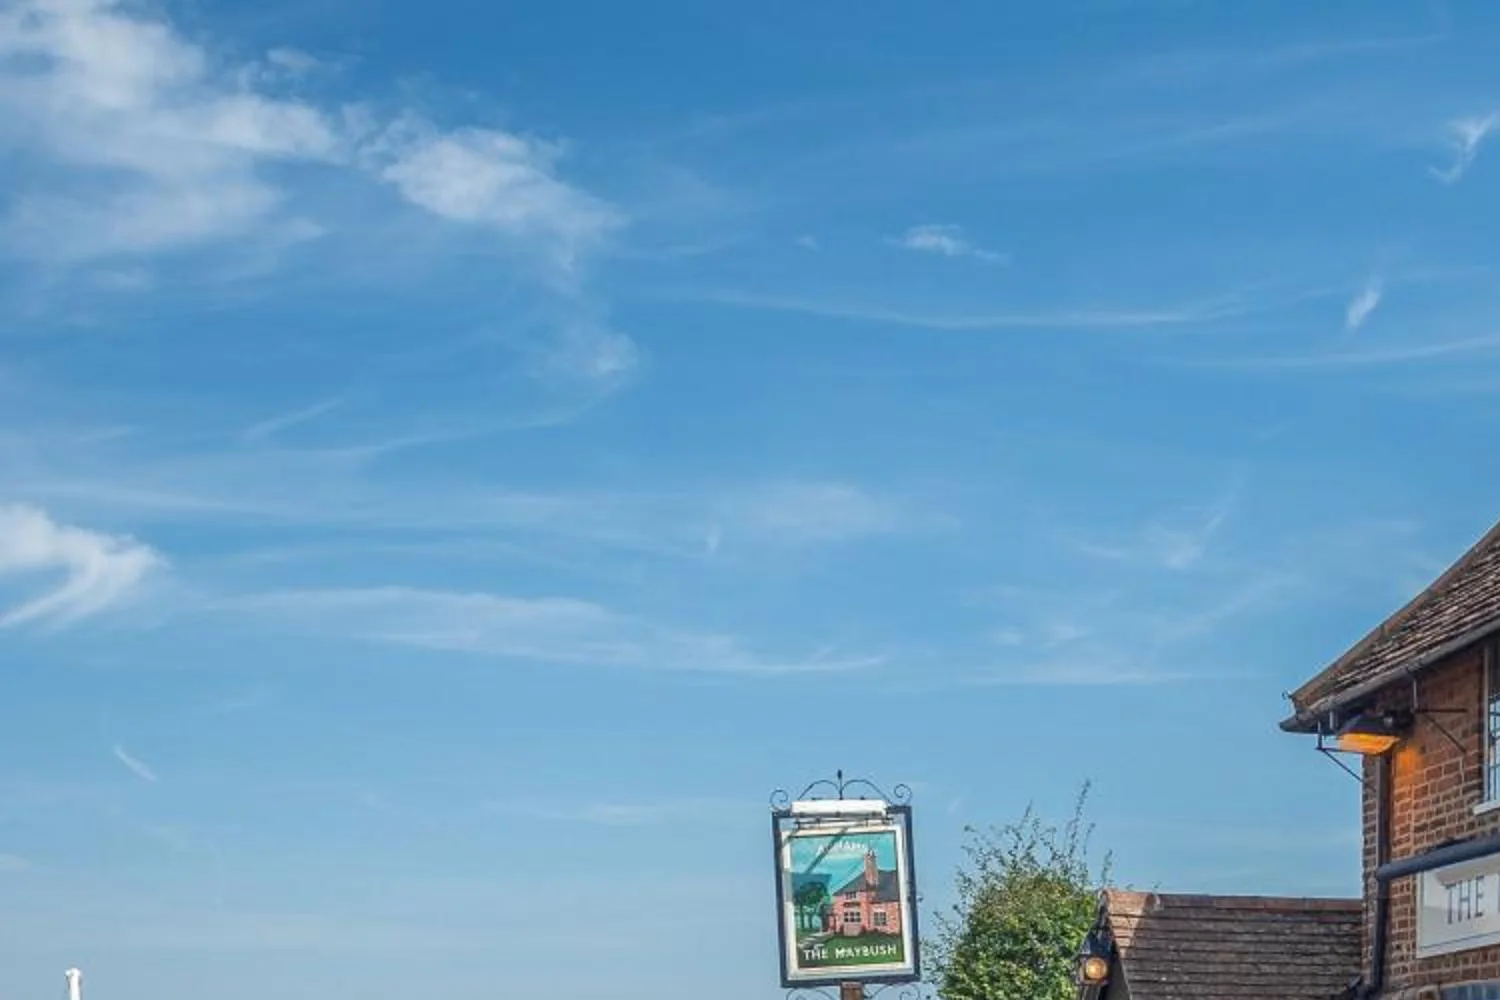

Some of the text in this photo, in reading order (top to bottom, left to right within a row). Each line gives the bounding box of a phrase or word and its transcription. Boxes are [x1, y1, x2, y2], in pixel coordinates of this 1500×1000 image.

[1445, 875, 1485, 925] THE
[803, 943, 897, 960] THE MAYBUSH
